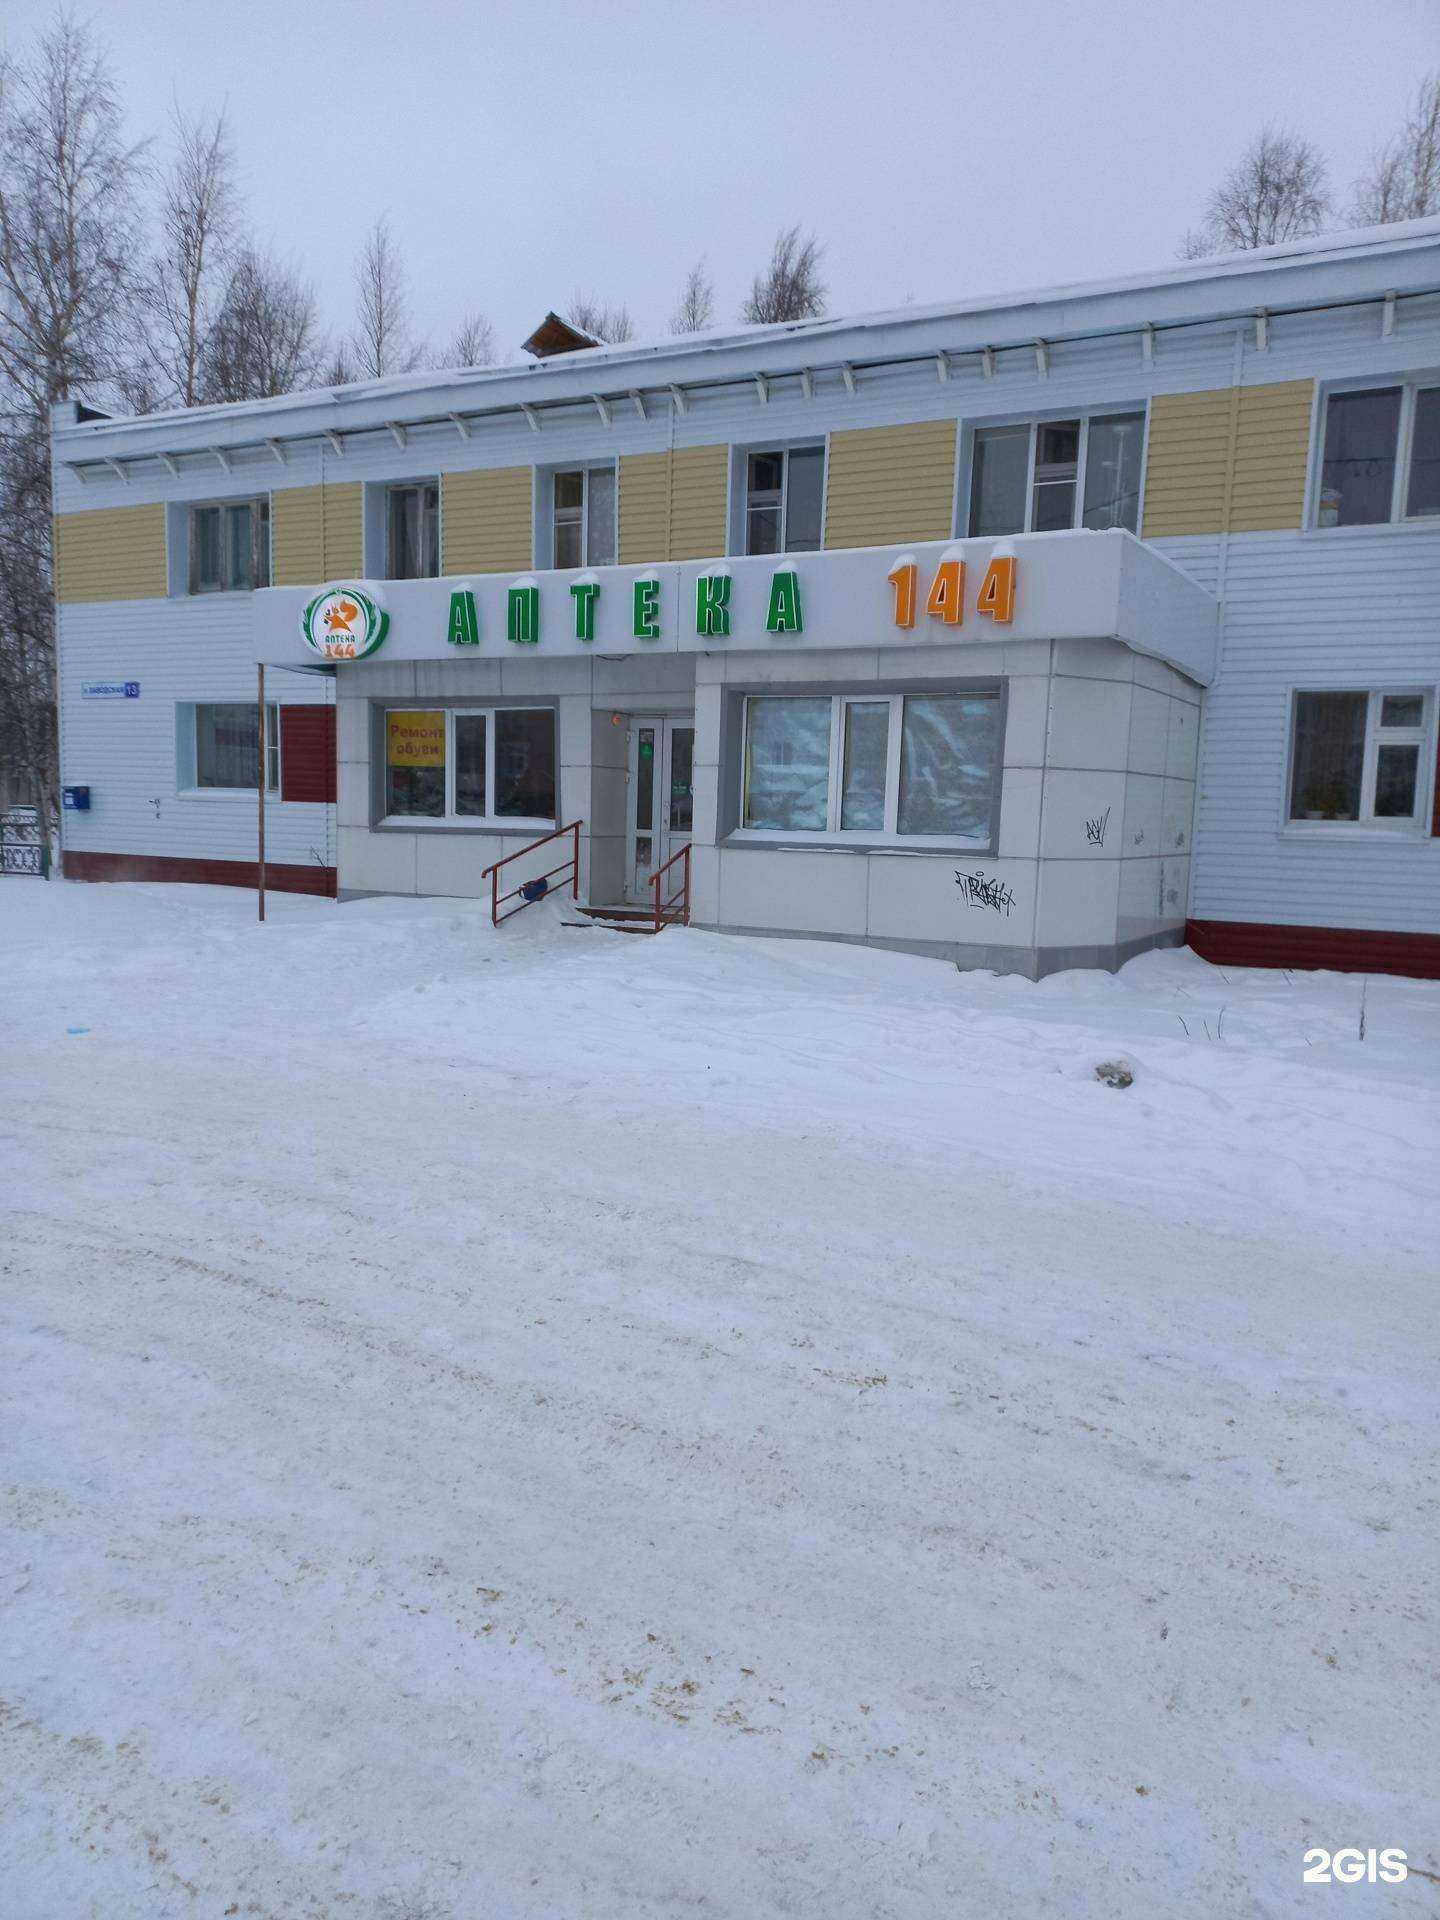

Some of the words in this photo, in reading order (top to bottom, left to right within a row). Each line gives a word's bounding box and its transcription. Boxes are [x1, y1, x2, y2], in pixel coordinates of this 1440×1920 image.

[447, 571, 803, 645] АПТЕКА
[887, 556, 1018, 630] 144
[324, 644, 356, 661] 144
[391, 724, 444, 738] Ремонт
[396, 742, 440, 758] обуви
